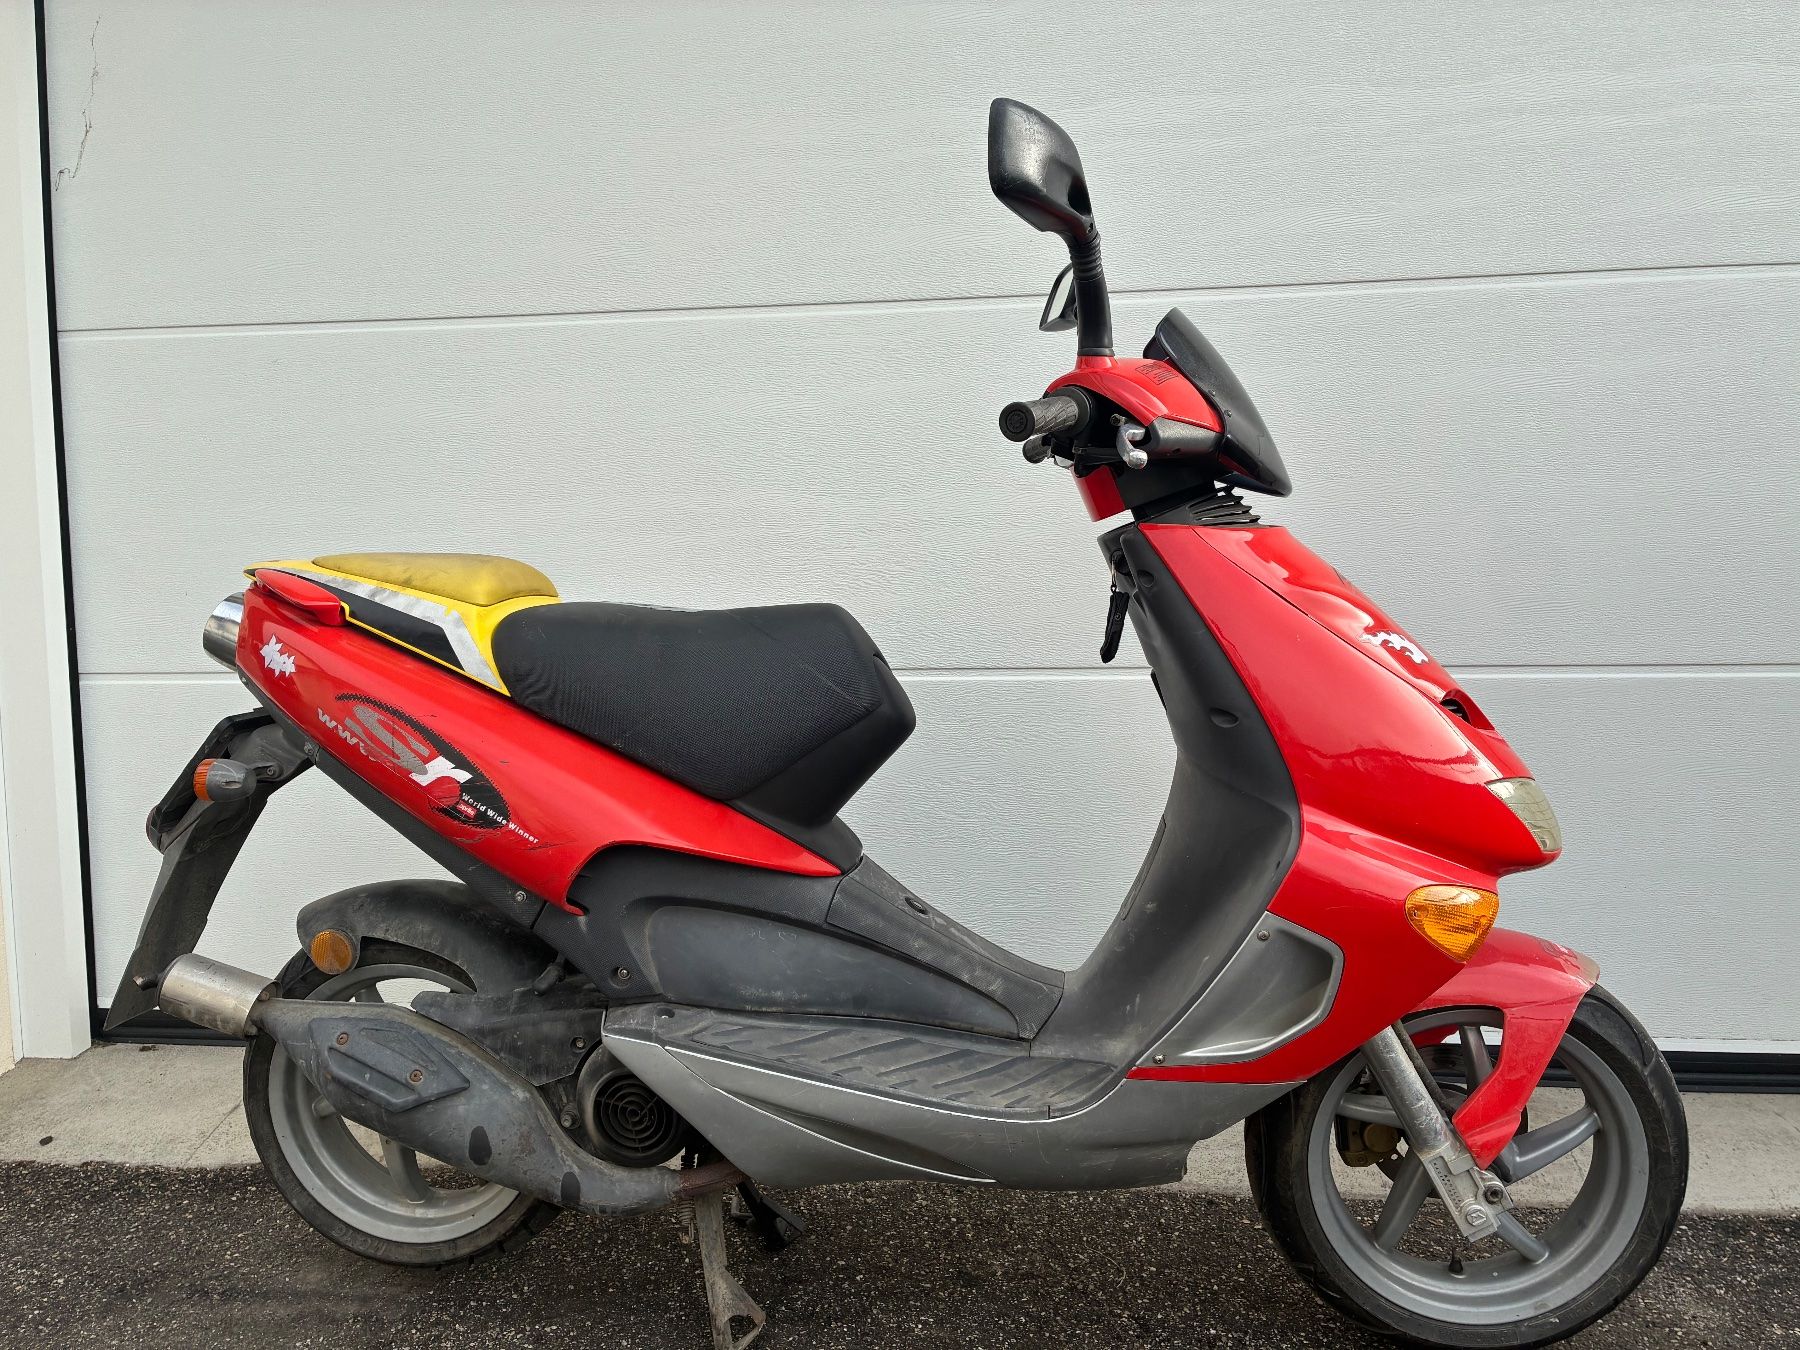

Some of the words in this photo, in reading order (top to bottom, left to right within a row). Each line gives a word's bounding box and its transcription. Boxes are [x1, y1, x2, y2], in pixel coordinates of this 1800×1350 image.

[462, 792, 487, 812] World
[487, 808, 507, 825] Wide
[508, 821, 539, 844] Winner
